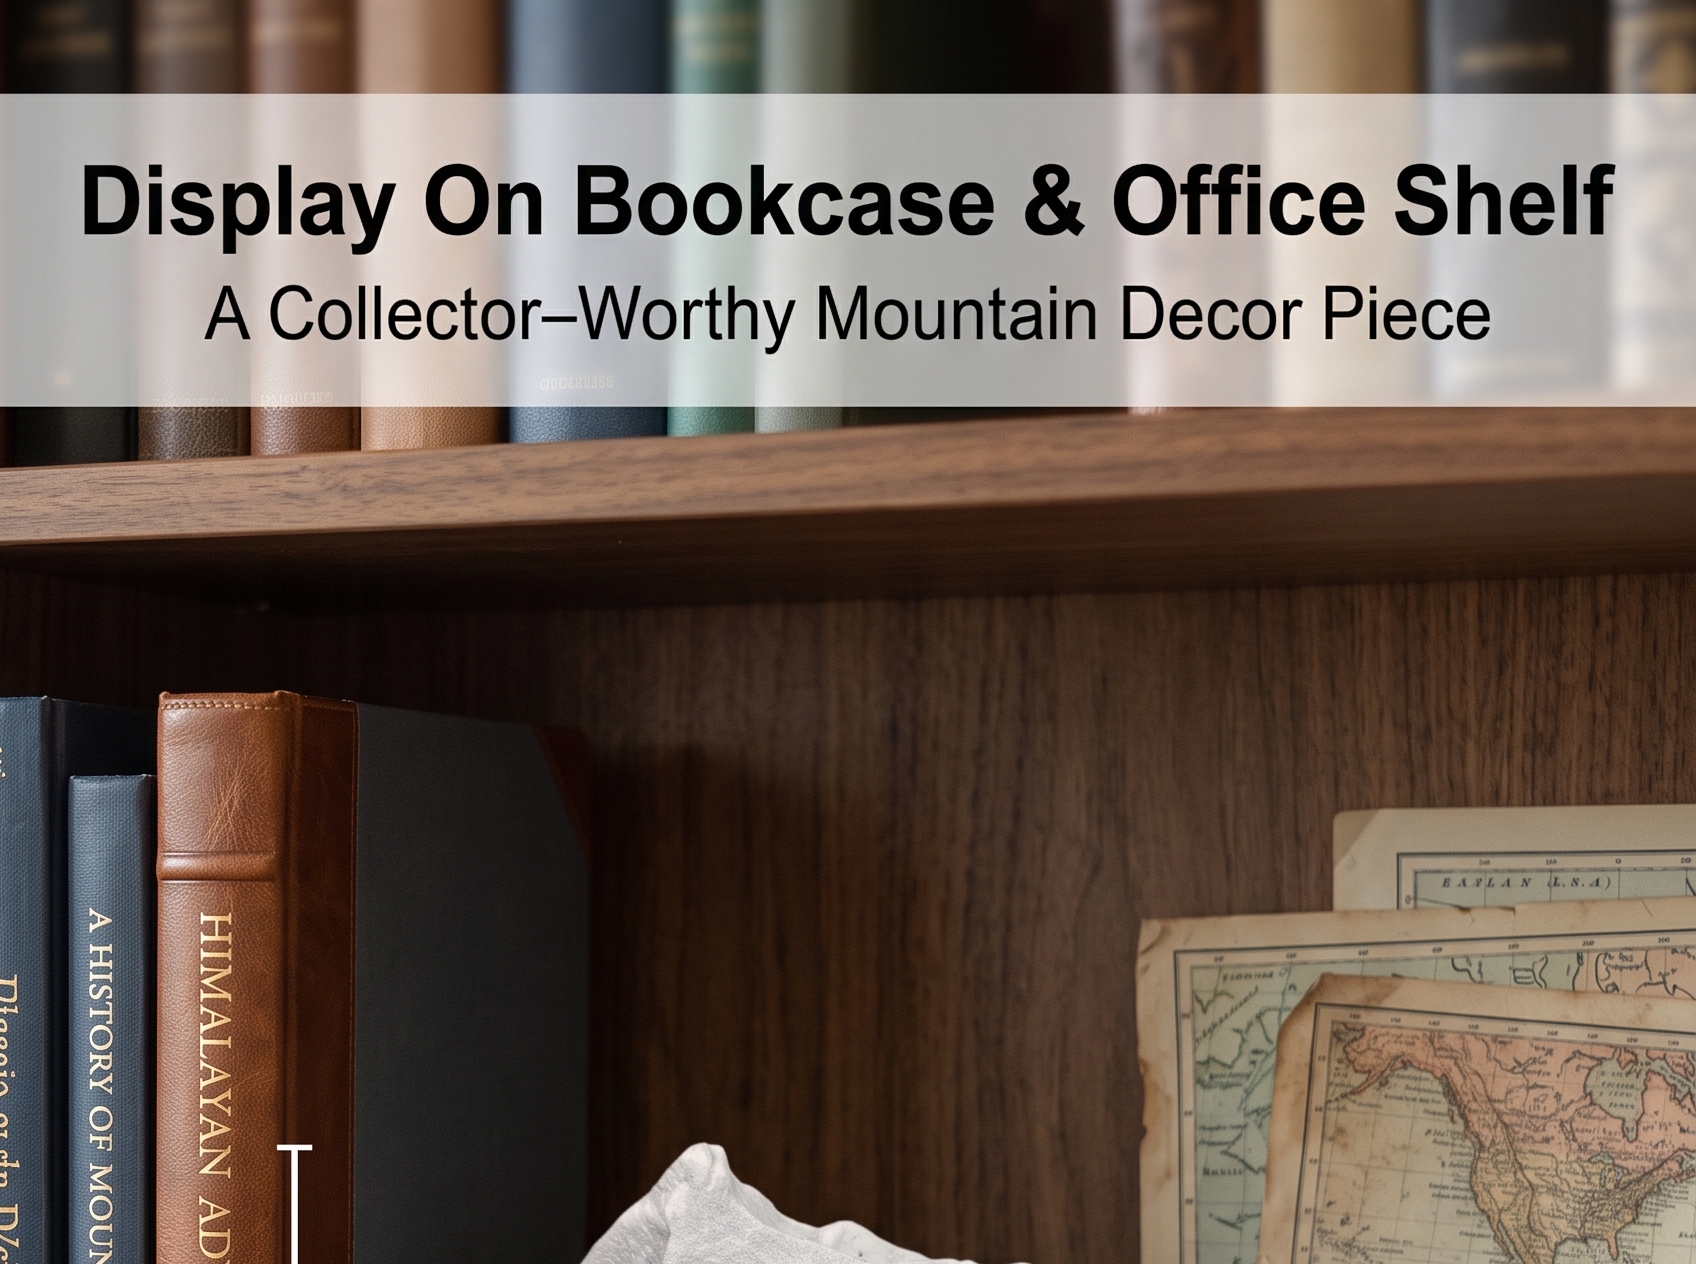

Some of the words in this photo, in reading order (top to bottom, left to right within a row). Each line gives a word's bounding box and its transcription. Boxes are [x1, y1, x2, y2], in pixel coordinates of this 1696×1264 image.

[90, 907, 113, 933] A
[90, 943, 114, 1095] HISTORY
[198, 911, 233, 1179] HIMALAYAN
[90, 1105, 114, 1152] OF
